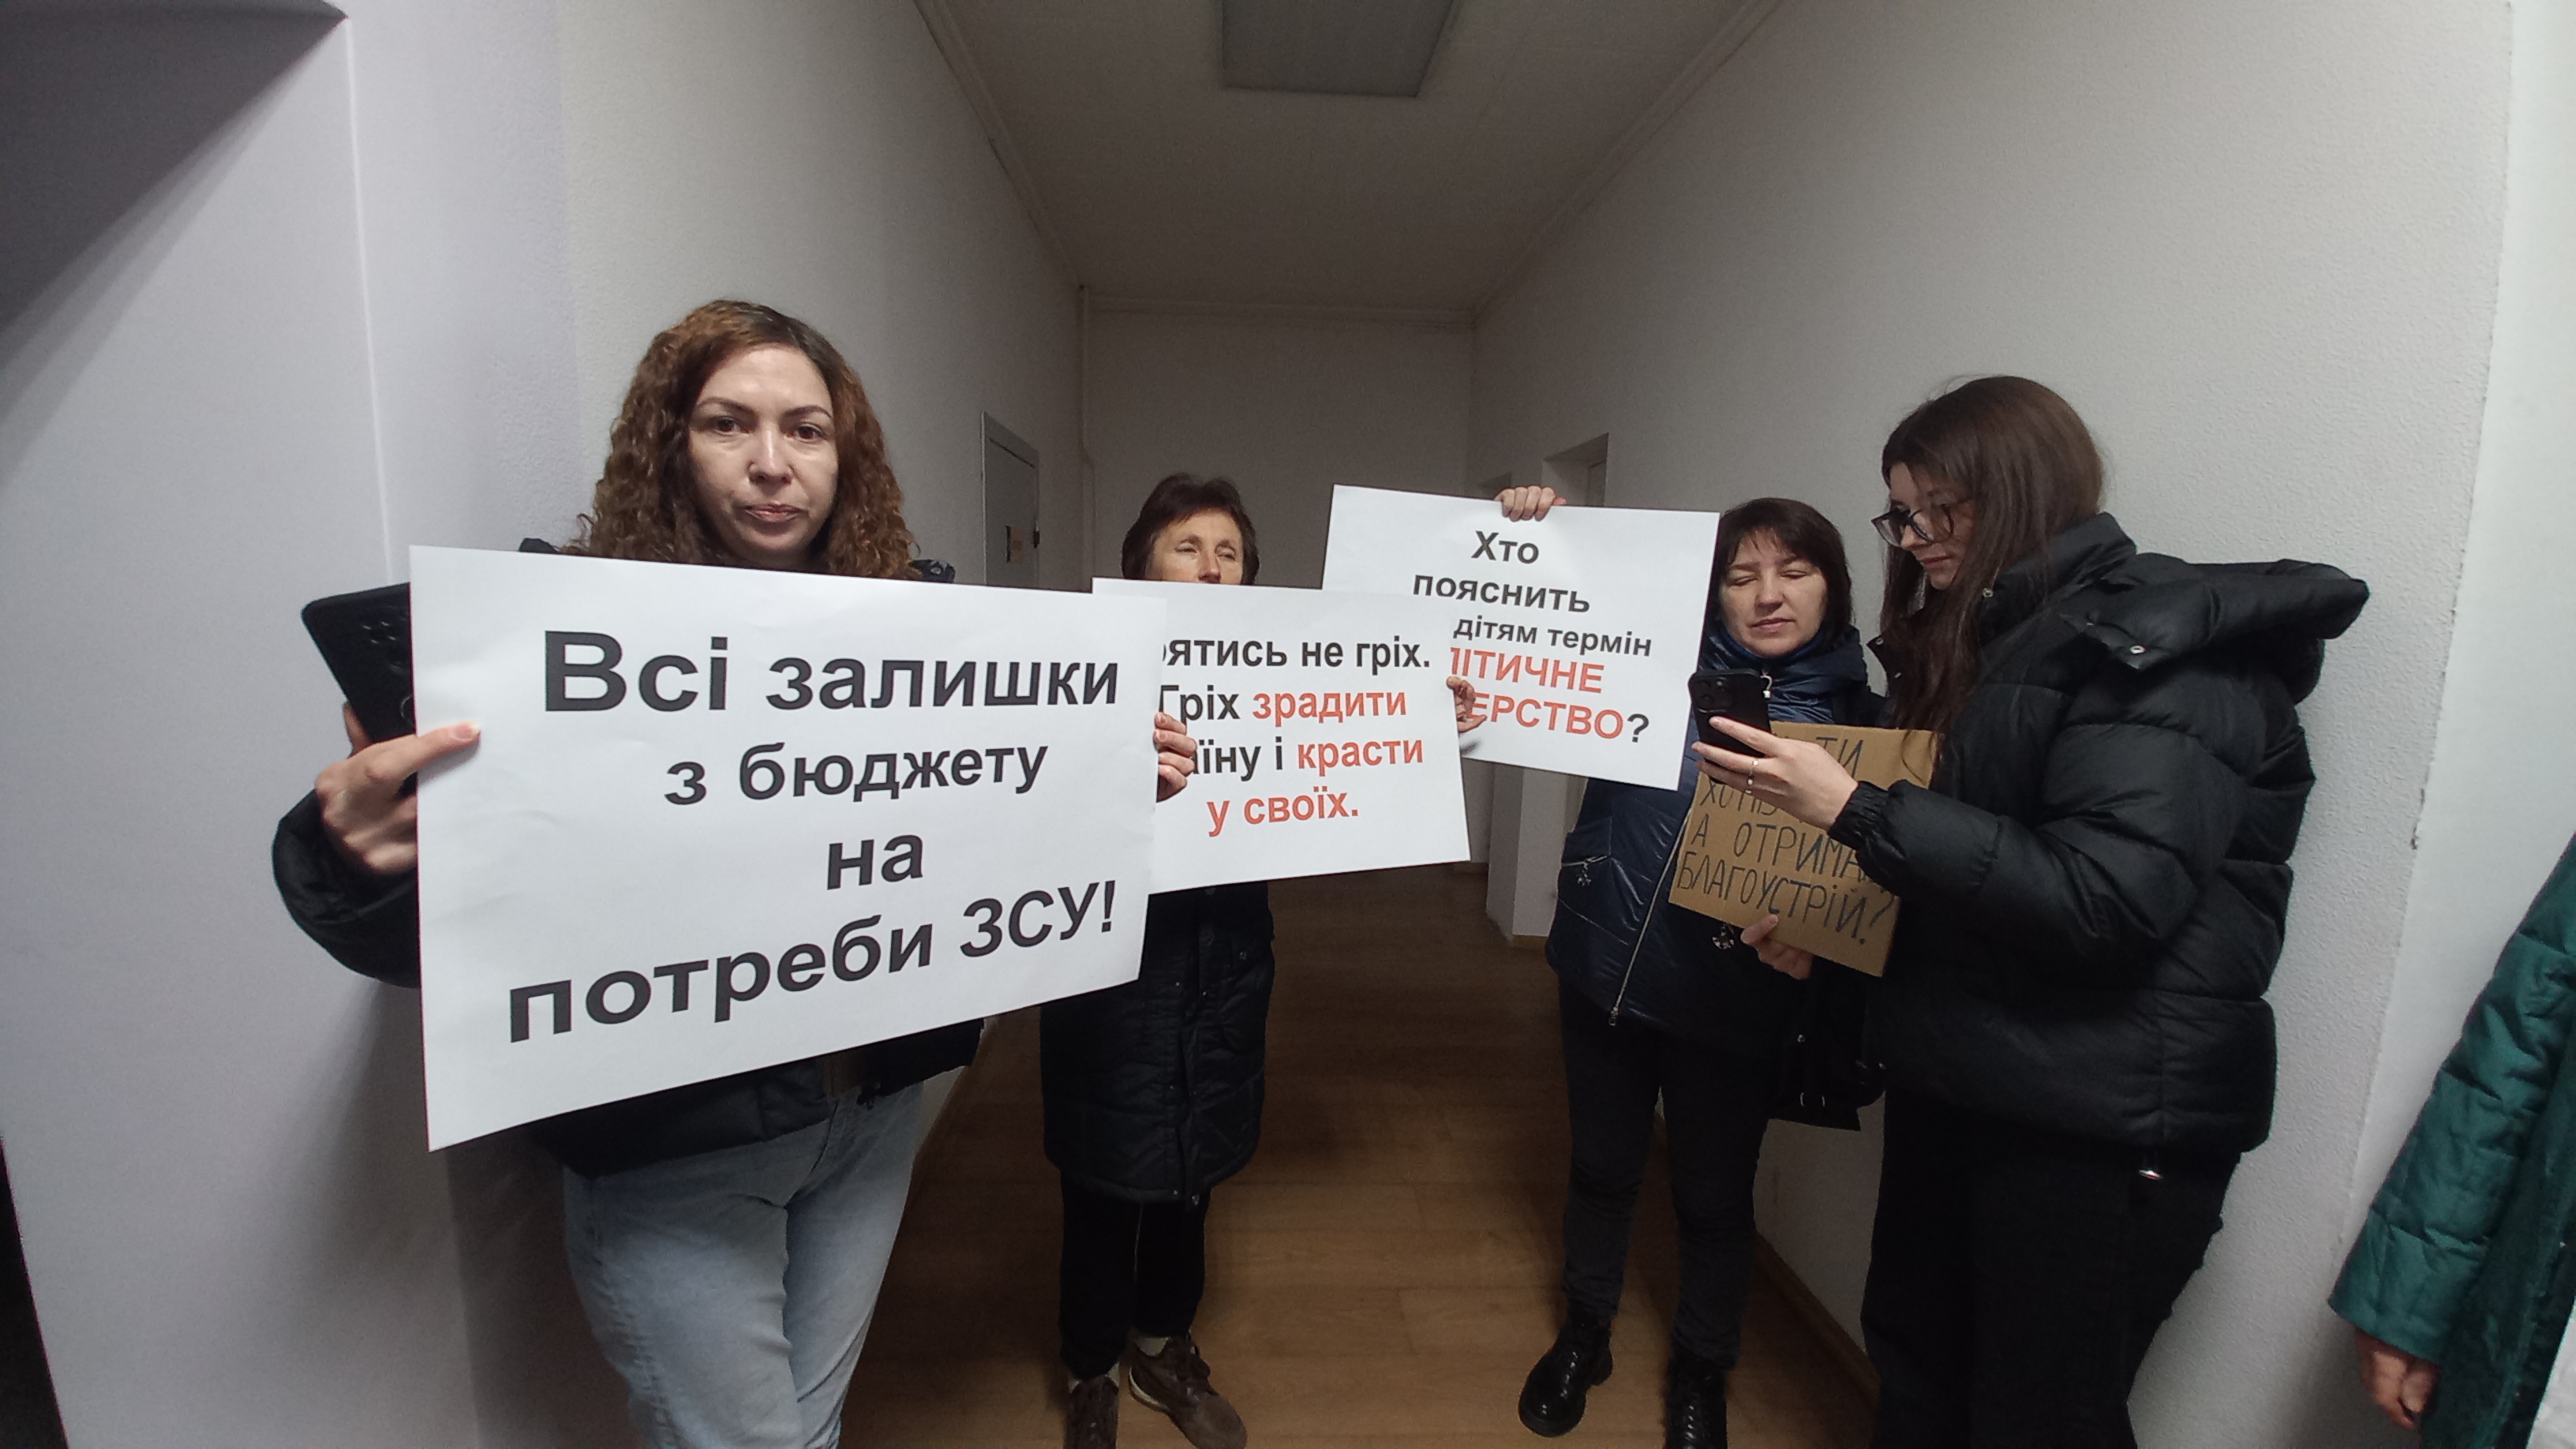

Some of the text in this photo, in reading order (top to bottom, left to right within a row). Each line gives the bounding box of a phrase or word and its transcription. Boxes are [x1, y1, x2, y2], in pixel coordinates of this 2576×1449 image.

[1471, 531, 1539, 564] Хто
[1413, 575, 1590, 612] пояснить
[1163, 635, 1430, 676] ятись не гріх.
[1453, 616, 1652, 657] дітям термін
[545, 631, 1118, 712] Всі залишки
[1159, 684, 1406, 727] Гріх зрадити
[665, 742, 1048, 805] з бюджету
[1275, 736, 1283, 770] і
[1298, 739, 1423, 777] красти
[1207, 786, 1358, 837] у своїх.
[827, 834, 923, 890] на
[1690, 814, 1866, 883] А ОТРИМА
[509, 880, 1115, 1043] потреби ЗСУ!
